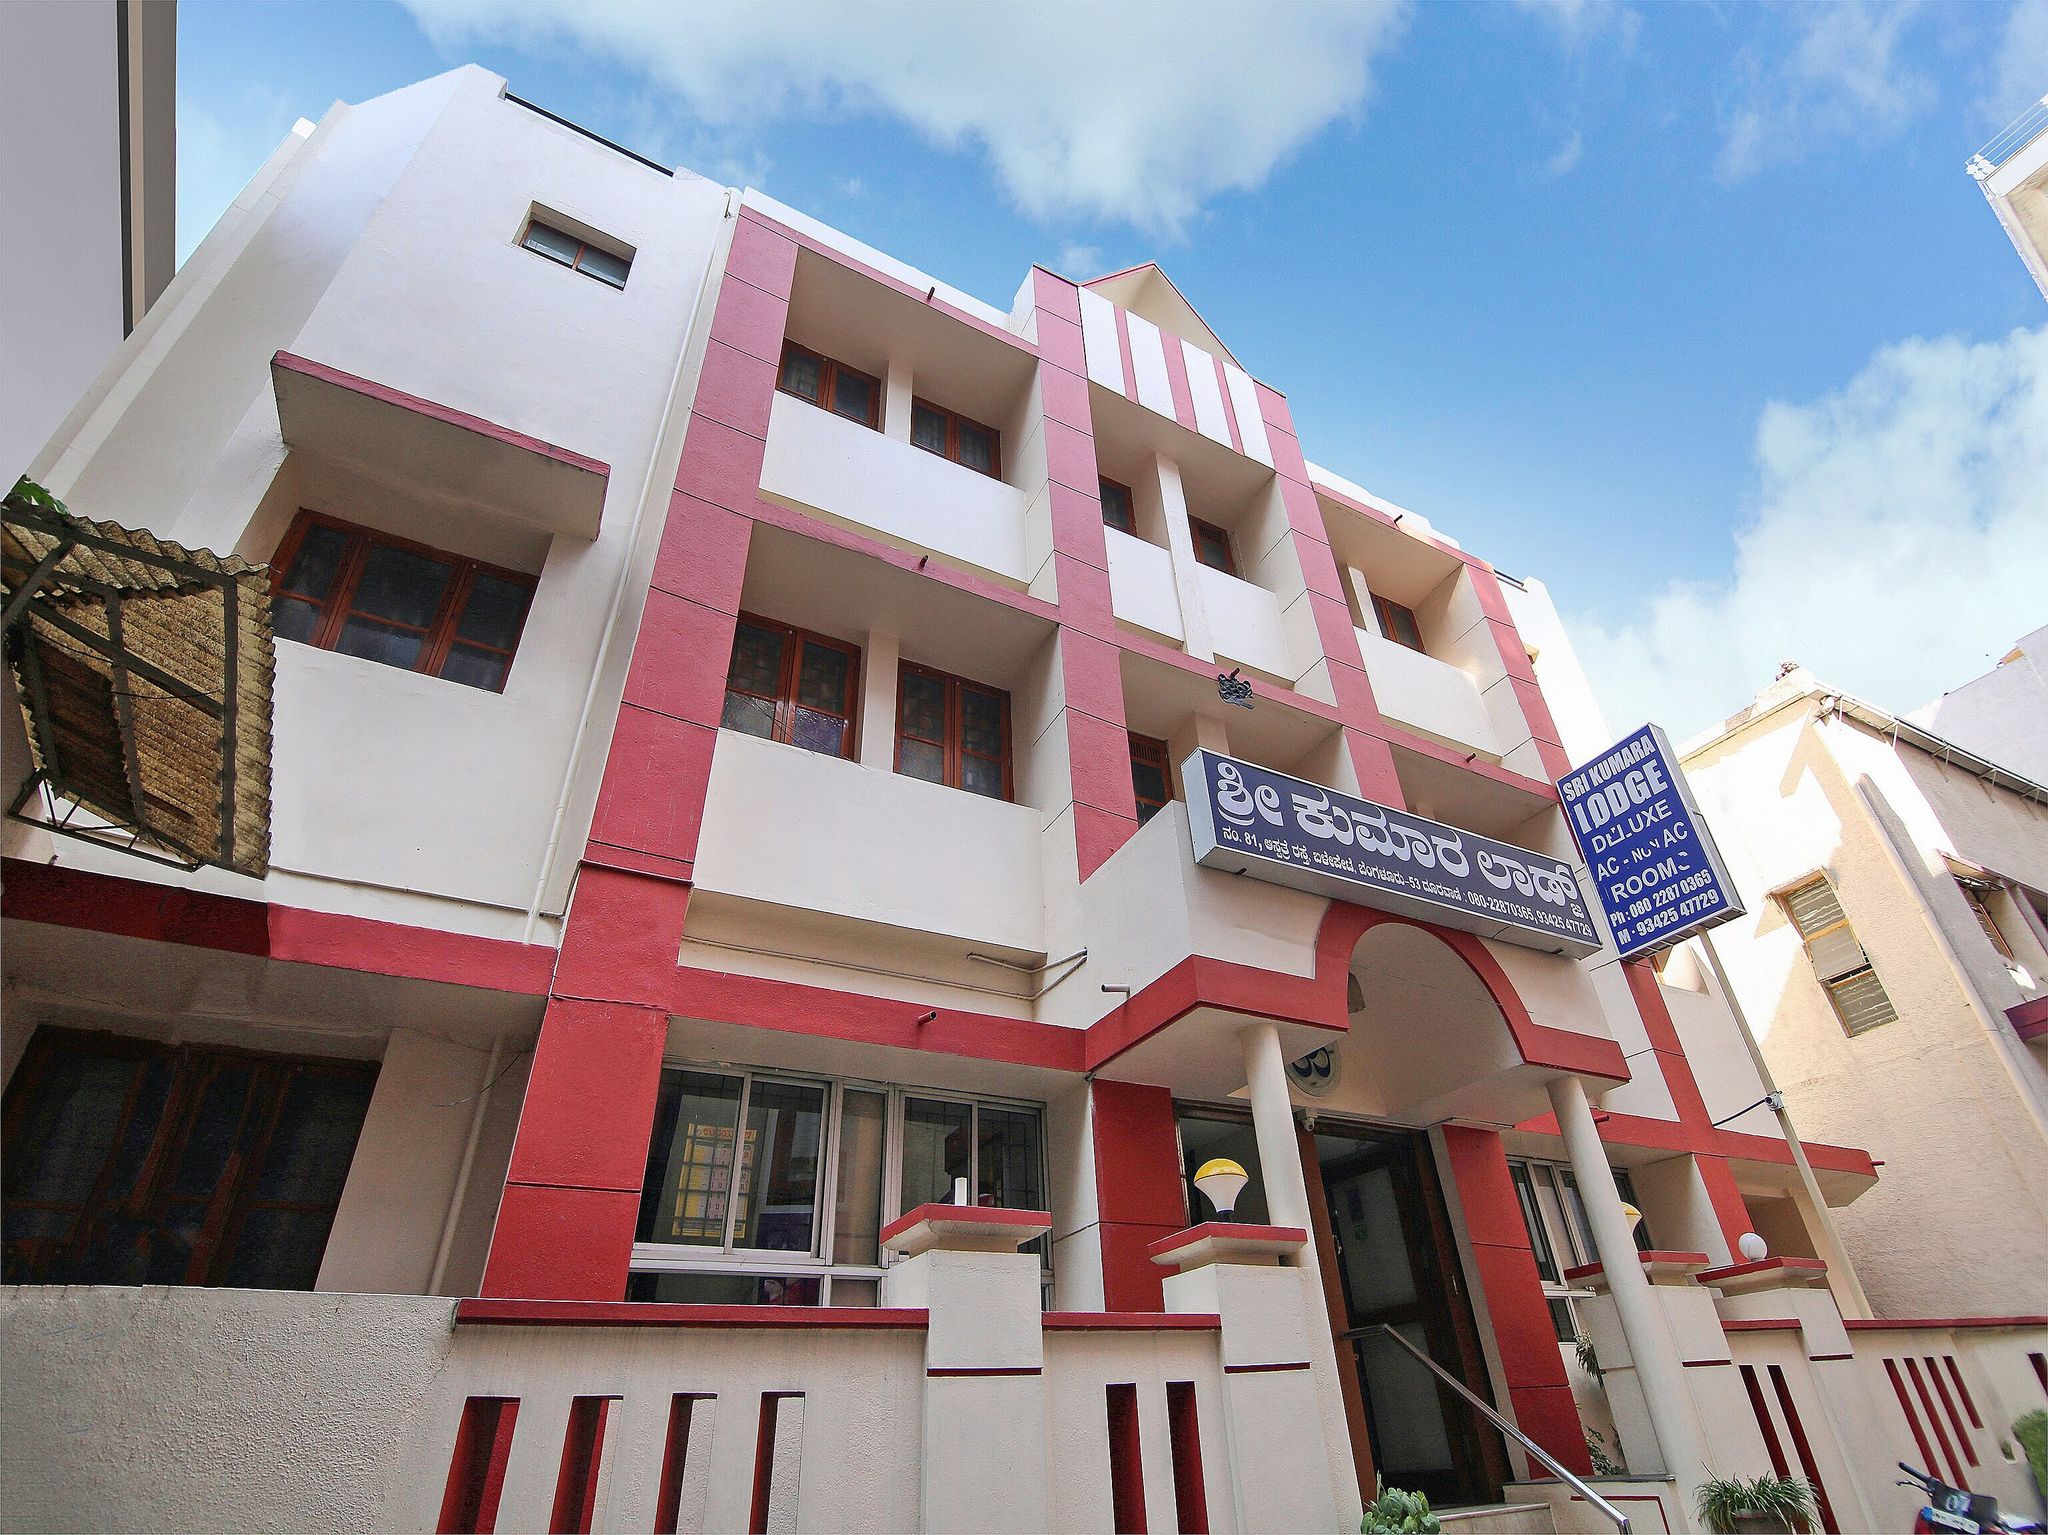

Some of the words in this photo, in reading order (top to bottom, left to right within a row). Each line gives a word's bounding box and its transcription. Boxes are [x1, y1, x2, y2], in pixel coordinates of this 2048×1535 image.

[1562, 773, 1590, 802] SRI
[1588, 734, 1656, 787] KUMARA
[1217, 762, 1284, 826] ಶ್ರೀ
[1291, 788, 1470, 877] ಕುಮಾರ
[1597, 857, 1620, 882] AC
[1663, 821, 1688, 848] AC
[1629, 898, 1652, 918] 080
[1653, 884, 1680, 908] 2287
[1679, 869, 1712, 894] 0365
[1636, 907, 1679, 936] 93425
[1679, 889, 1719, 917] 47729
